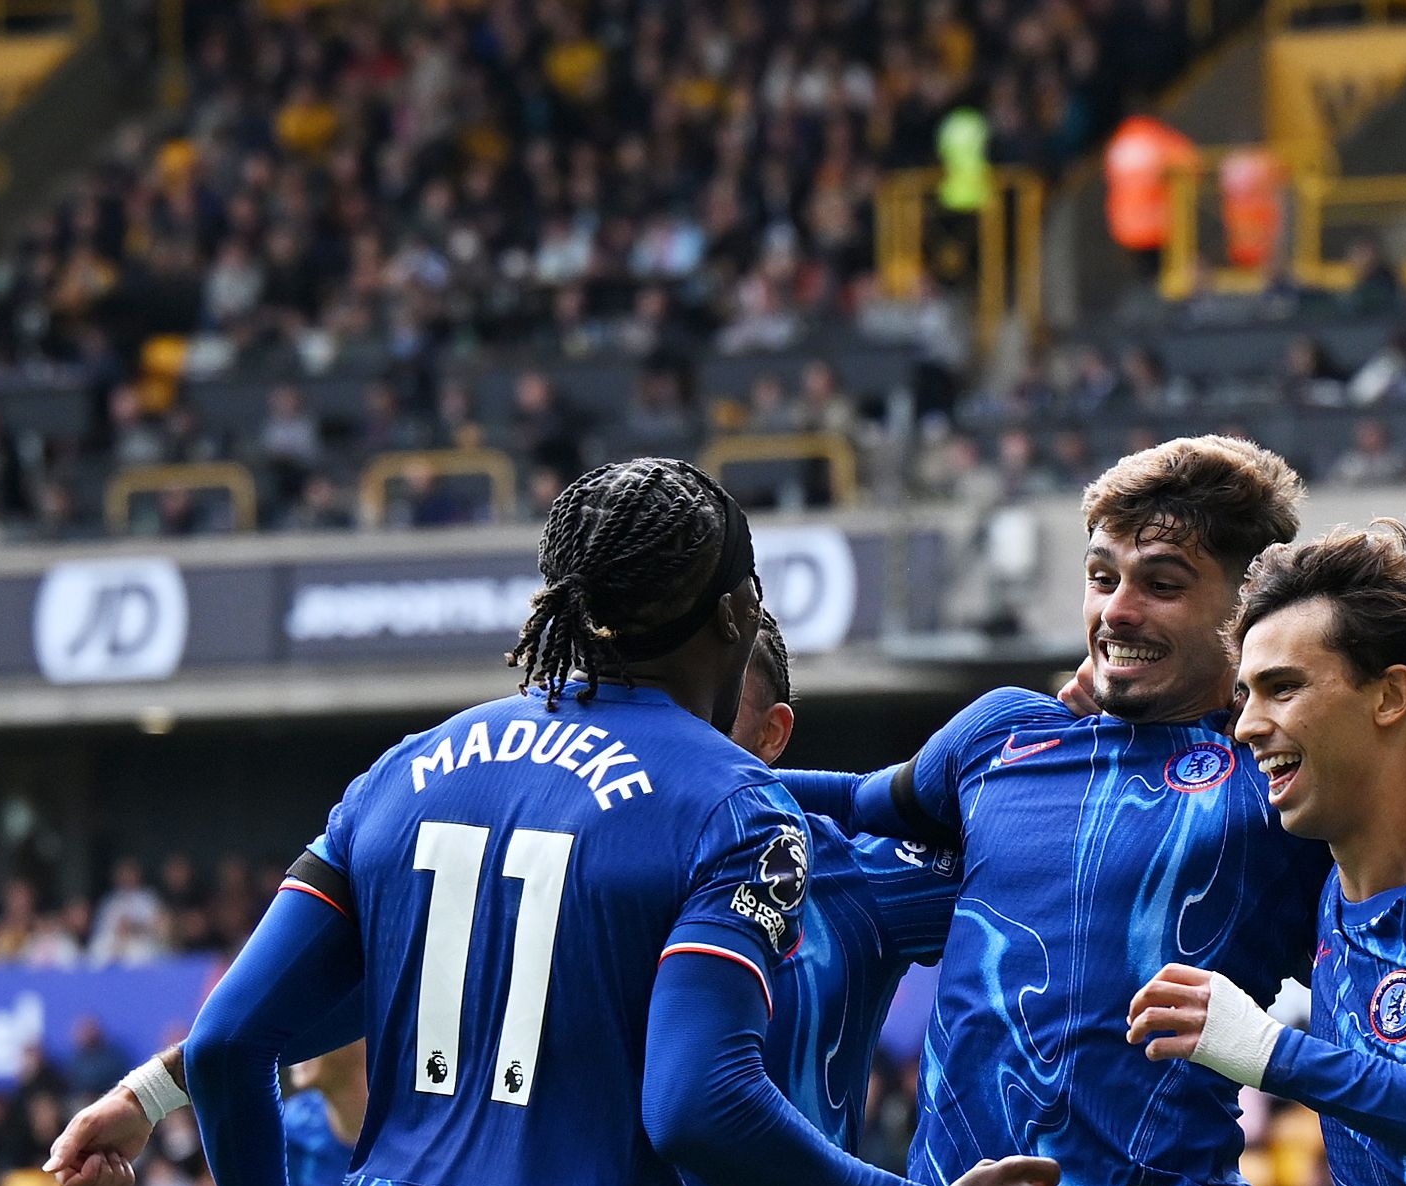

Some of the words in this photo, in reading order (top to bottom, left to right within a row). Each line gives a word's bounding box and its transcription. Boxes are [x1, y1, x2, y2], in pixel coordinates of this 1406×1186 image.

[67, 584, 159, 657] JD
[411, 719, 653, 810] MADUEKE
[413, 820, 575, 1106] 11
